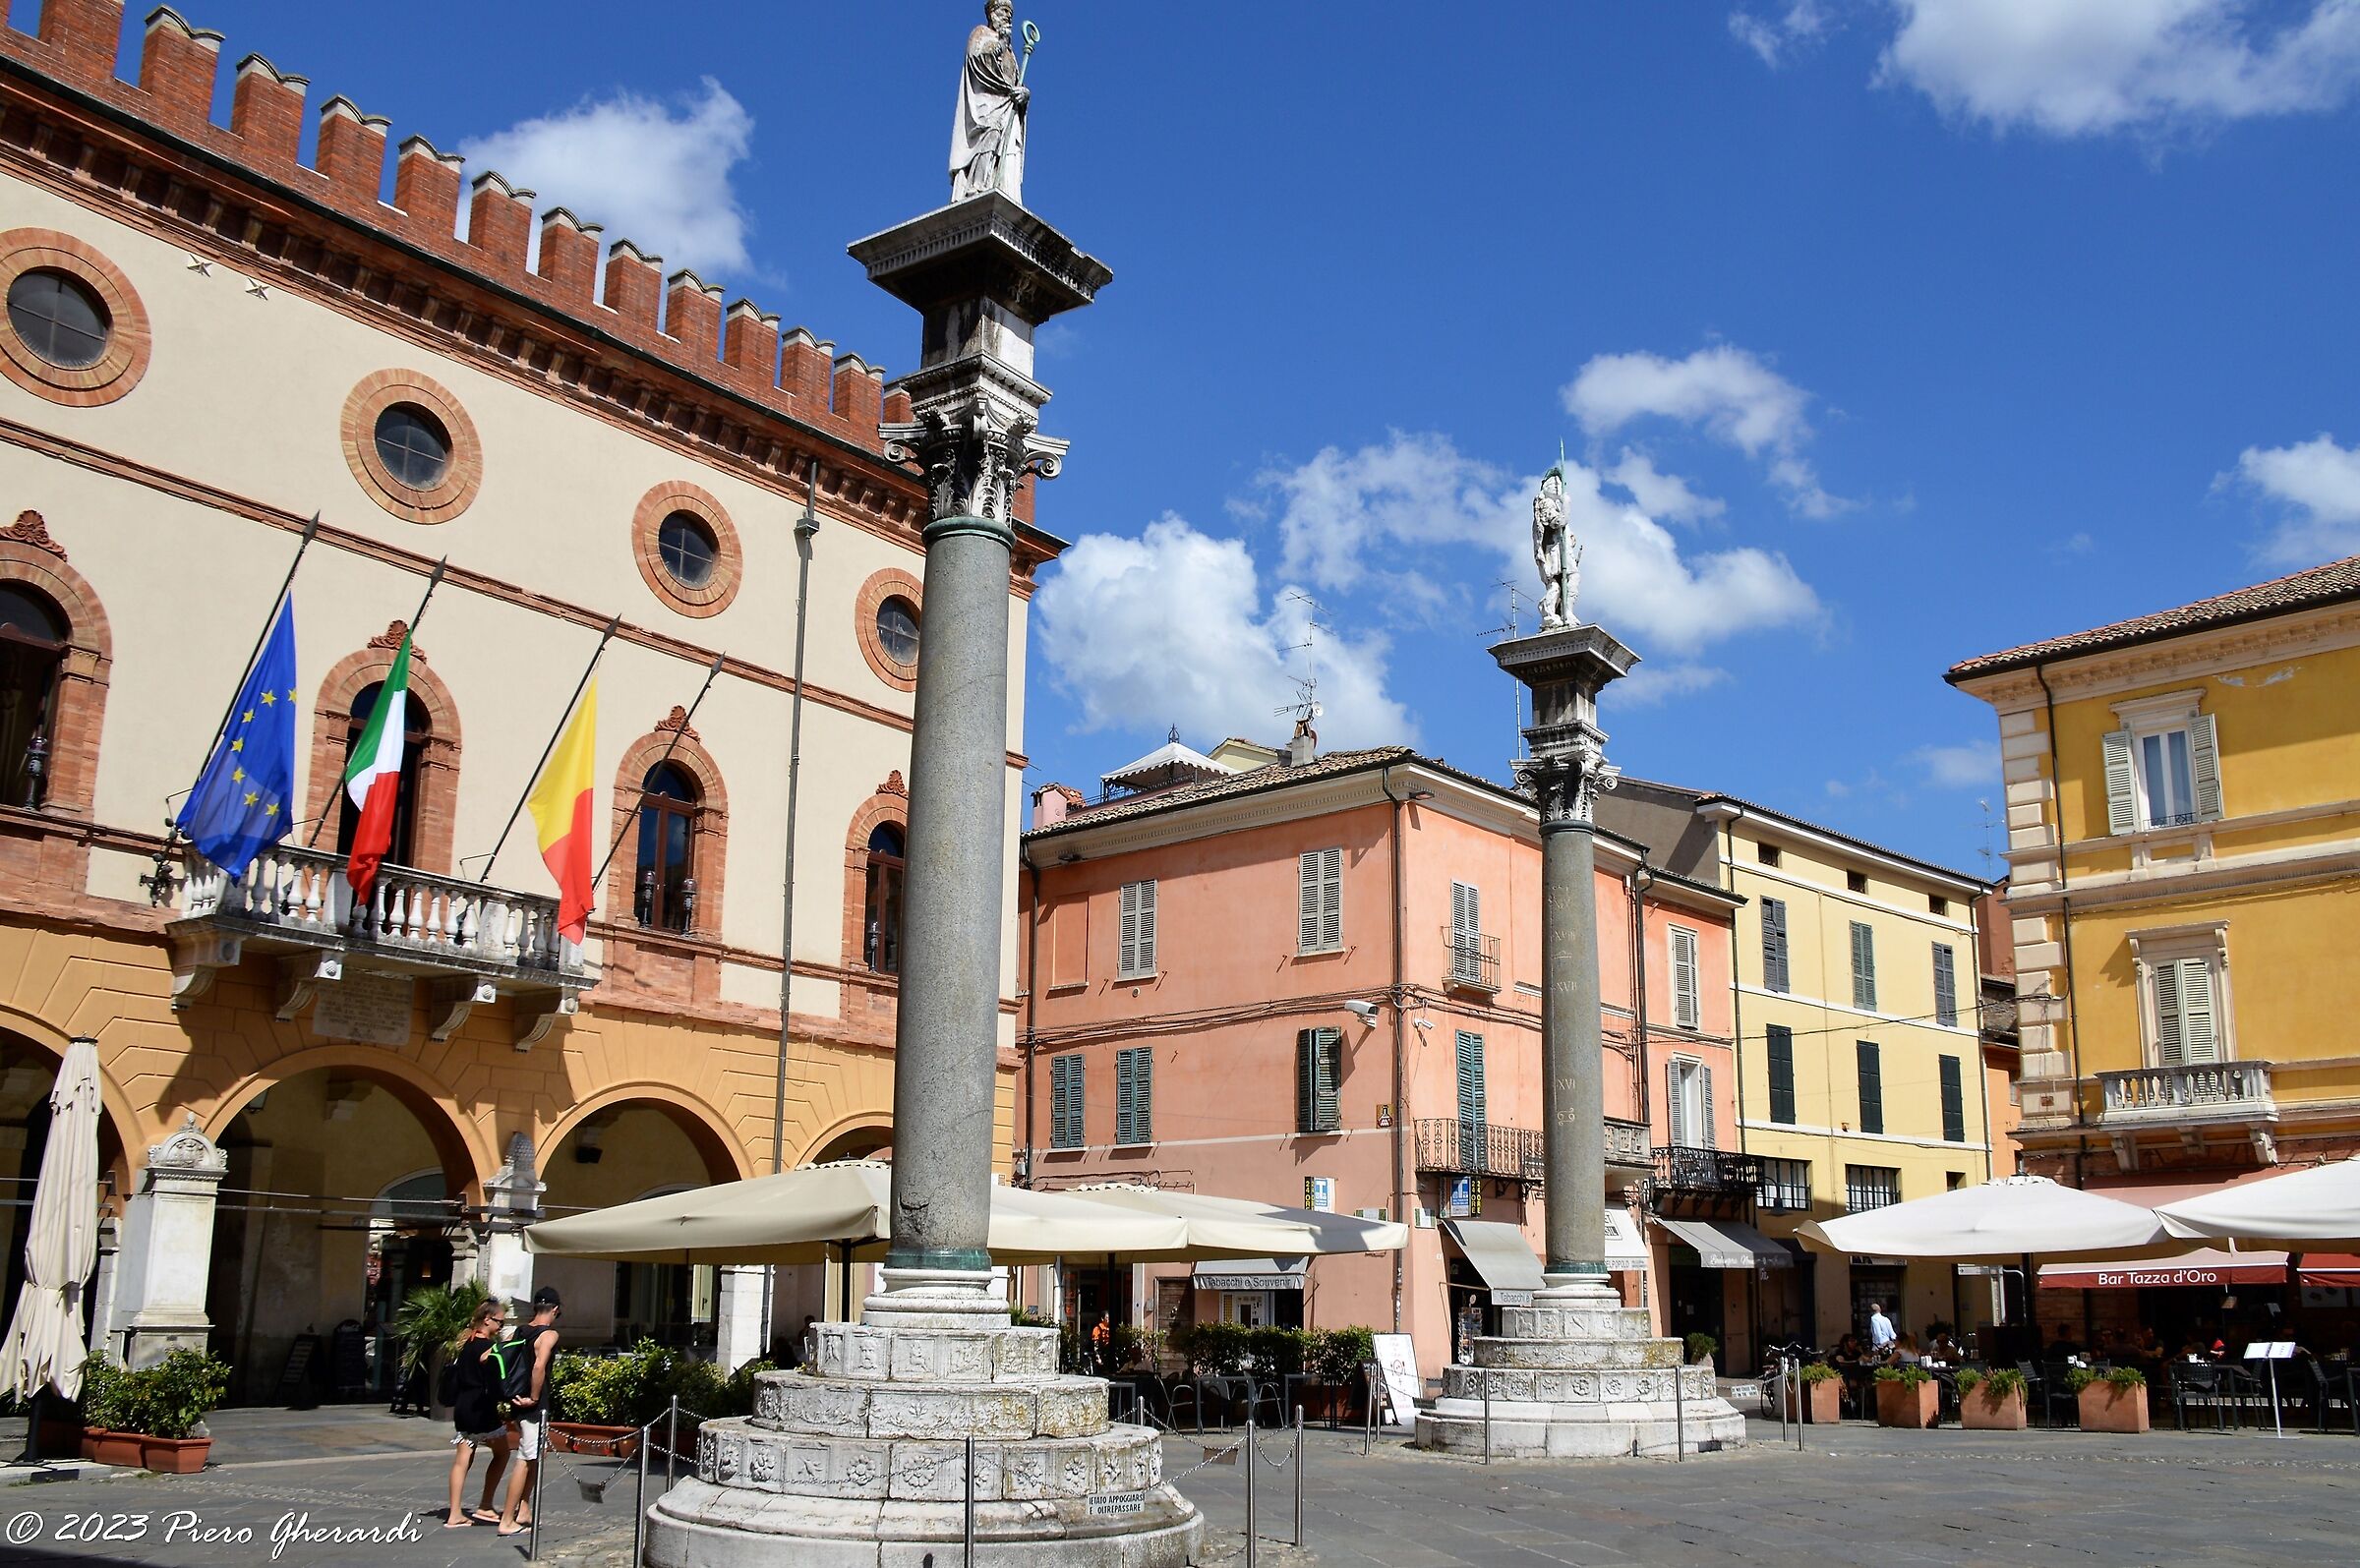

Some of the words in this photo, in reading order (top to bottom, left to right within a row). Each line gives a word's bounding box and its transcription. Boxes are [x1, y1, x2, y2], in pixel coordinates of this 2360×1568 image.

[1305, 1181, 1311, 1193] 24
[1471, 1181, 1476, 1193] 24
[1476, 1181, 1481, 1193] 24
[1207, 1277, 1243, 1287] Tabacchi
[1253, 1276, 1291, 1287] Souvenir
[2097, 1273, 2124, 1286] Bar
[2126, 1271, 2170, 1285] Tazza
[2173, 1269, 2217, 1284] d'Oro
[1089, 1506, 1092, 1515] E
[1097, 1503, 1141, 1515] OLTREPASSARE
